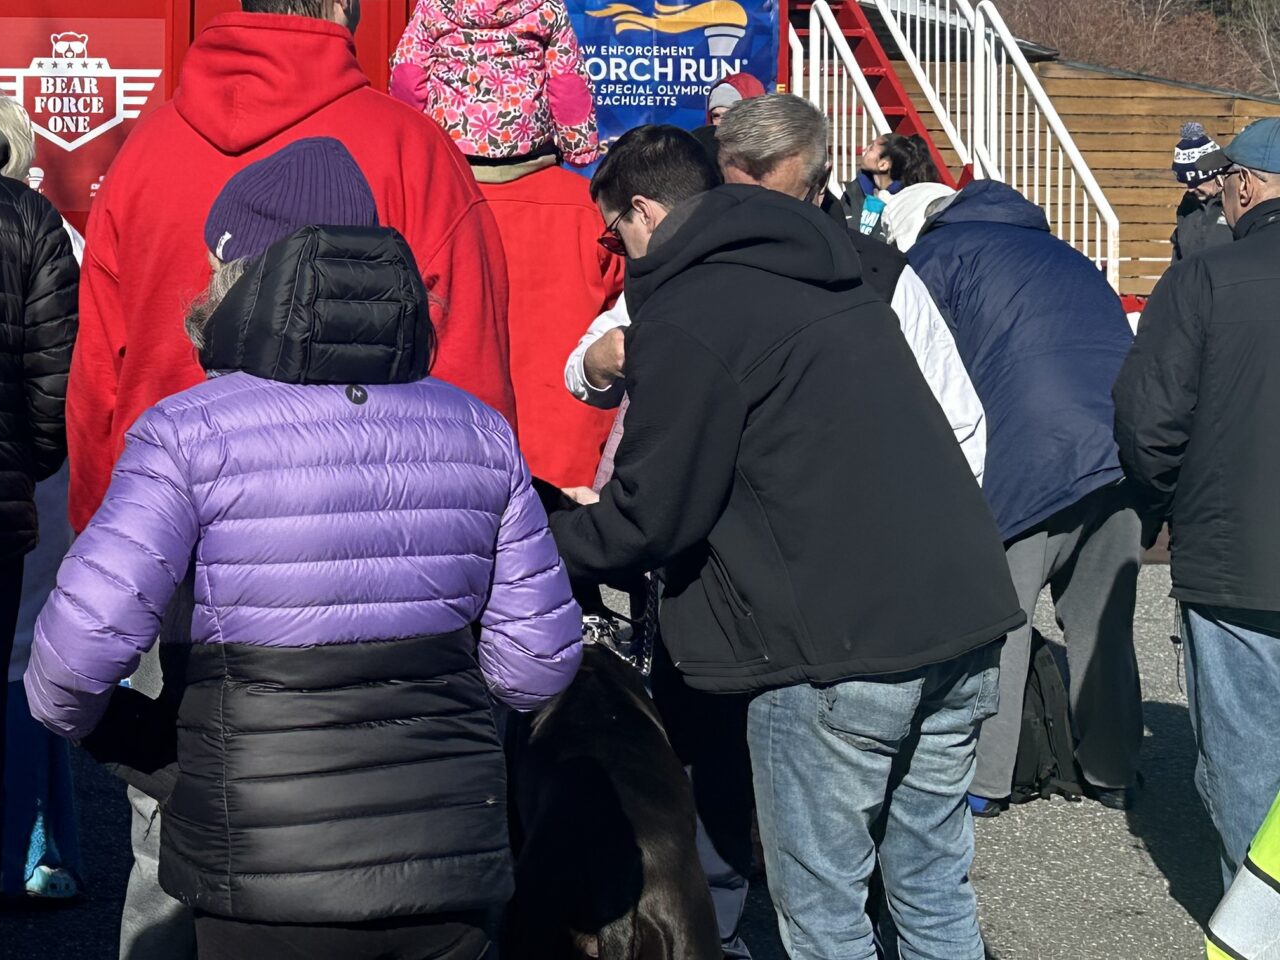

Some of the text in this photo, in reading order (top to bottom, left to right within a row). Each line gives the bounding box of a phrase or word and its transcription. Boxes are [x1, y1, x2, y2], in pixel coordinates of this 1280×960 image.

[601, 46, 694, 56] ENFORCEMENT
[585, 57, 741, 82] ORCH RUN
[40, 77, 99, 94] BEAR
[600, 84, 652, 94] SPECIAL
[657, 85, 711, 95] OLYMPIC
[34, 96, 104, 113] FORCE
[596, 96, 677, 106] SACHUSETTS
[48, 115, 90, 133] ONE
